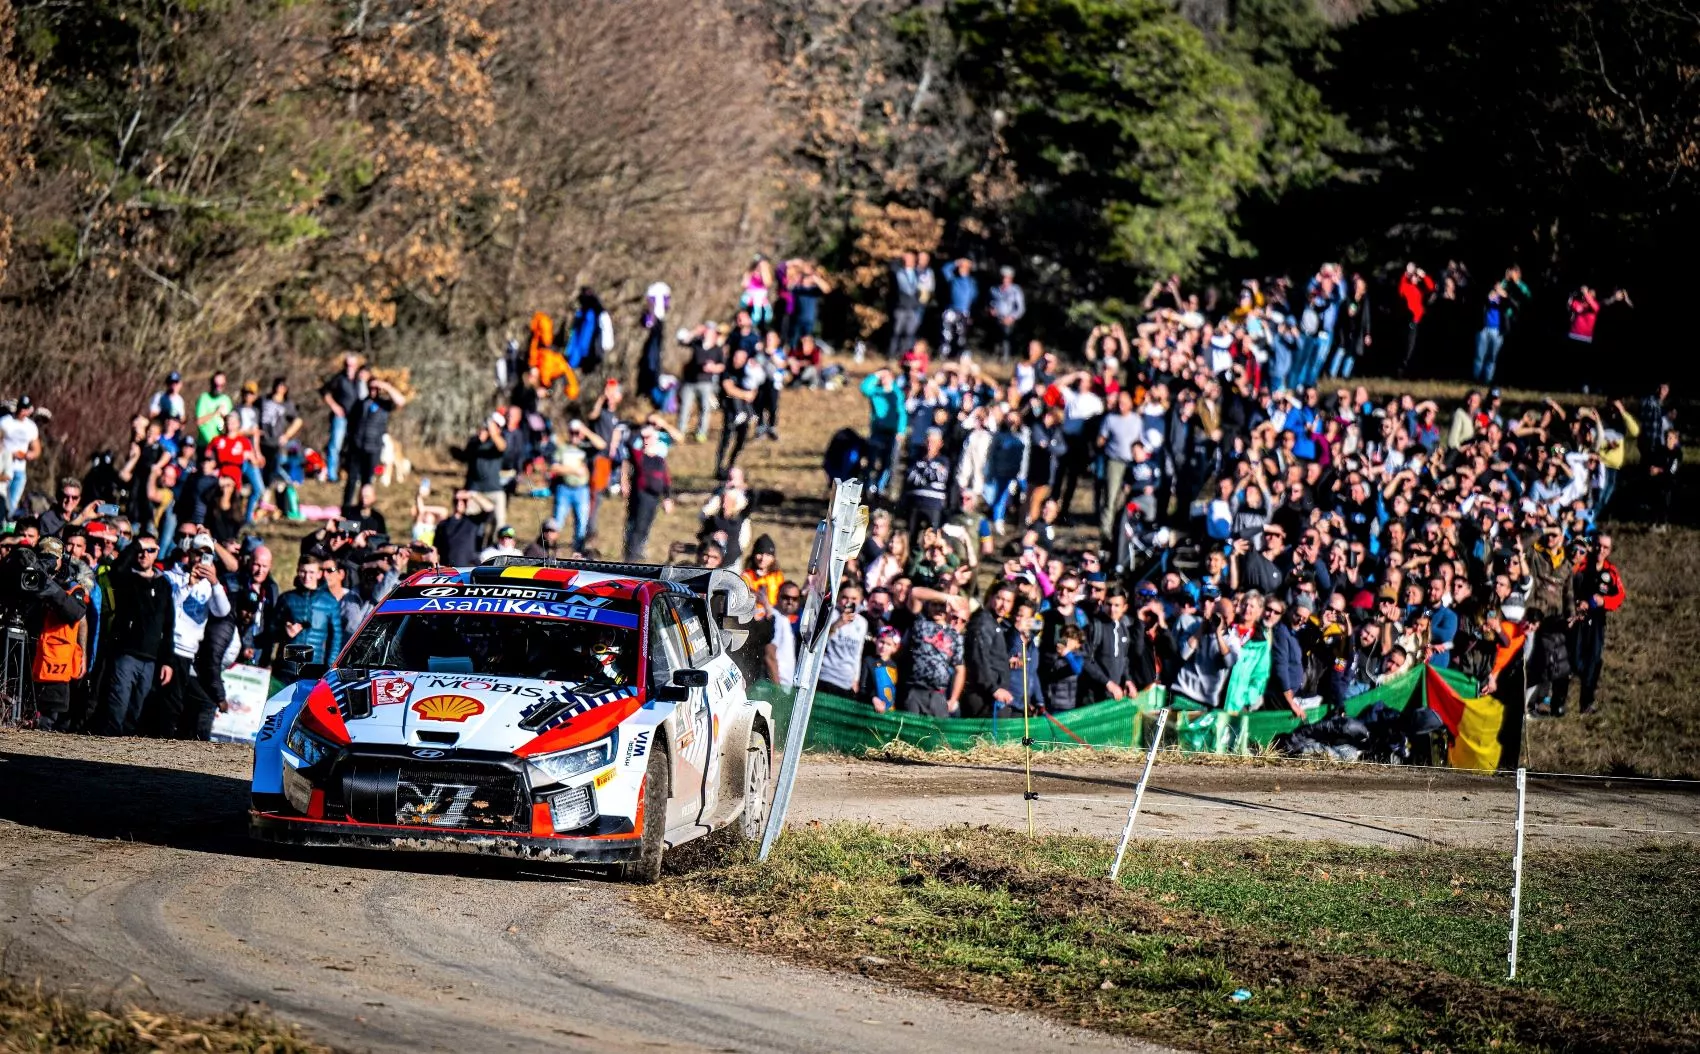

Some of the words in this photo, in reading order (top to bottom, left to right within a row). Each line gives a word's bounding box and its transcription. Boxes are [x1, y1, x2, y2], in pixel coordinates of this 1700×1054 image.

[463, 587, 557, 600] HYUNDAI
[46, 663, 67, 674] 127
[428, 679, 543, 698] MOBIS
[633, 730, 650, 757] WIA
